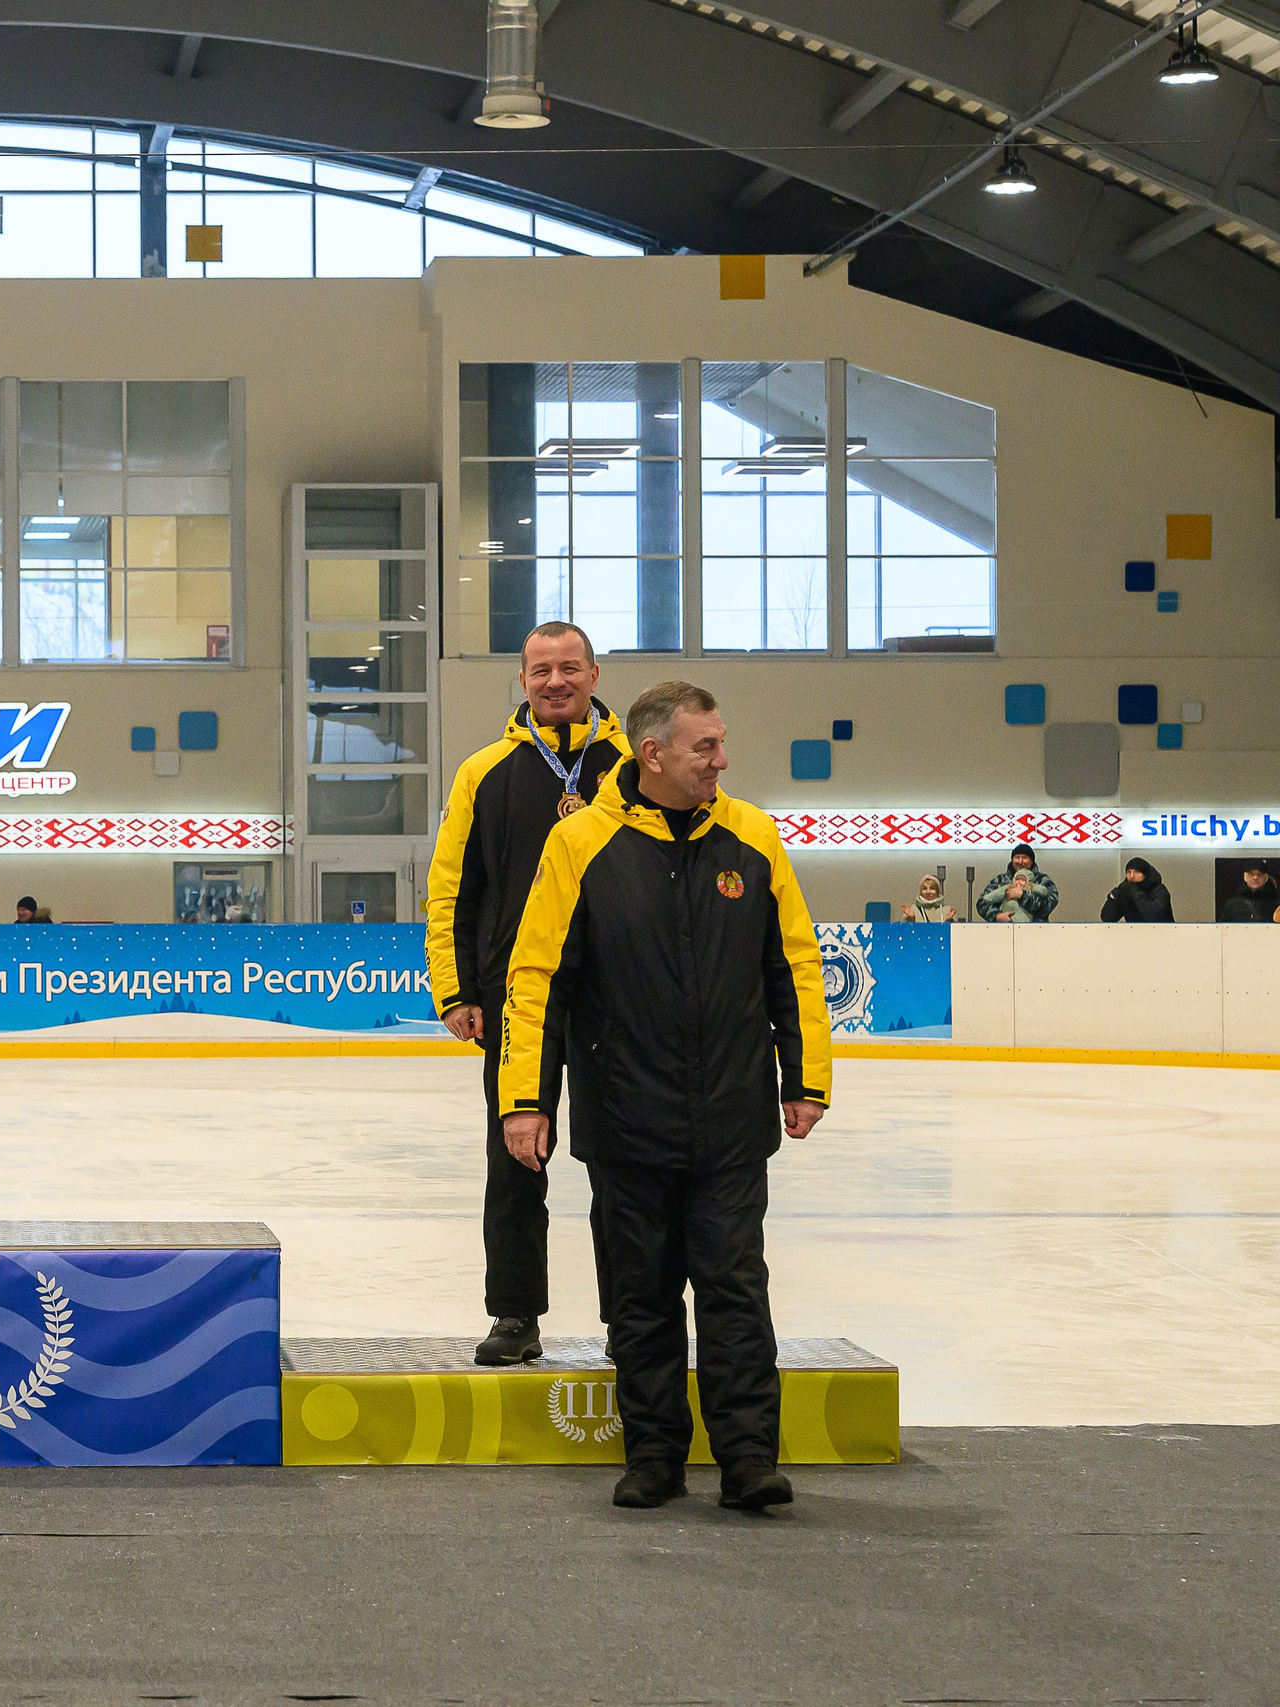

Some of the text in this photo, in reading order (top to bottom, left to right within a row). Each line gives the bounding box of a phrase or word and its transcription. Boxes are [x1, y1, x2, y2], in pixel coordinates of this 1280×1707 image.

[1, 777, 71, 794] ЦЕНТР
[18, 962, 232, 1002] Президента
[243, 960, 433, 1003] Республик
[561, 1382, 618, 1418] III
